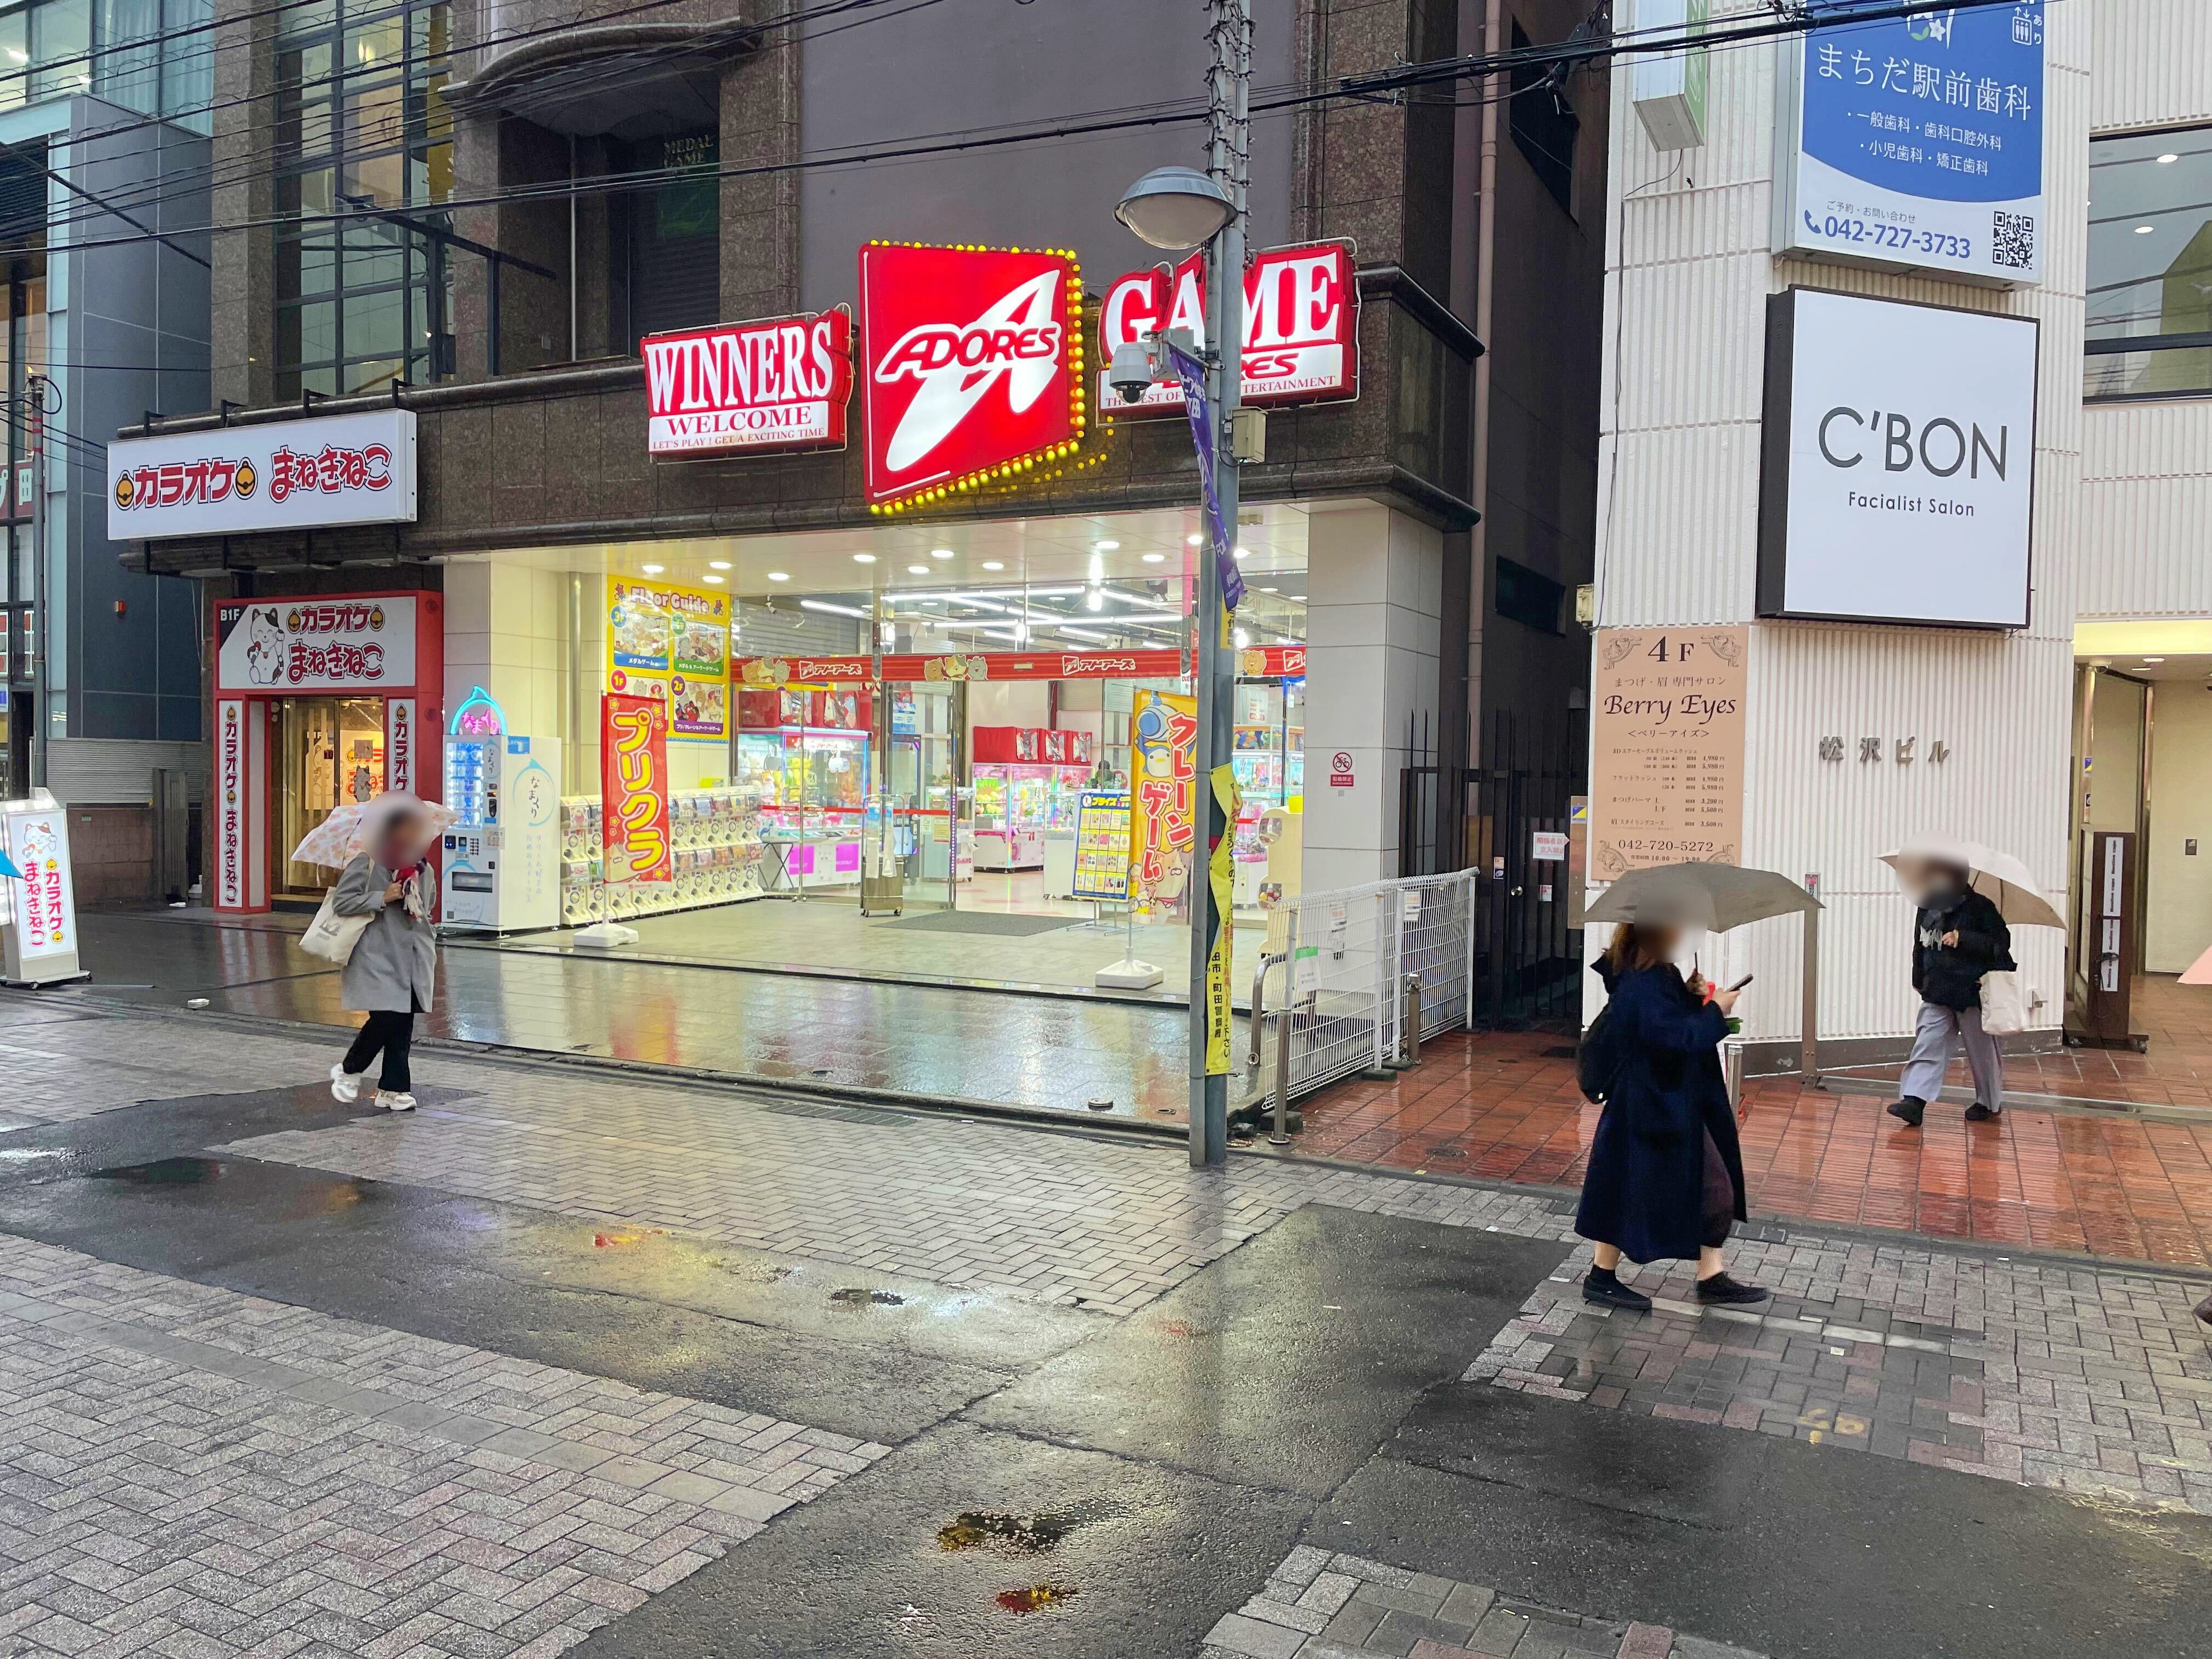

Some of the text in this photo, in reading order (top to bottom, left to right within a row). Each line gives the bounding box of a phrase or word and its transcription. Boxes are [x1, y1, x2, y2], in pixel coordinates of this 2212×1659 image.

[2033, 14, 2042, 44] あり
[1818, 43, 2031, 121] まちだ駅前歯科
[1827, 200, 1916, 224] ご予約・お問い合わせ
[1825, 216, 1971, 258] 042-727-3733
[1106, 252, 1340, 359] GAME
[645, 320, 832, 413] WINNERS
[881, 327, 1058, 375] ADORES
[1106, 375, 1335, 407] TH EST OF TERTAINMENT
[653, 441, 678, 449] LET'S
[682, 438, 705, 447] PLAY
[715, 436, 734, 444] GET
[748, 431, 794, 442] EXCITING
[798, 427, 825, 437] TIME
[667, 406, 812, 436] WELCOME
[1819, 407, 2007, 482] C'BON
[134, 444, 392, 507] カラオケ まねきねこ
[1849, 492, 1974, 516] Facialist Salon
[220, 610, 239, 622] B1F
[300, 605, 371, 633] カラオケ
[631, 586, 709, 614] Floor Guide
[287, 641, 385, 684] まねきねこ
[1604, 695, 1736, 725] Berry Eyes
[224, 721, 238, 790] カラオケ
[395, 721, 409, 791] カラオケ
[1819, 736, 1950, 763] 松沢ビル
[612, 708, 665, 871] プリクラ
[1167, 712, 1197, 847] クレーン
[1139, 780, 1173, 883] ゲーム
[1618, 839, 1713, 852] 042-720-5272
[224, 808, 239, 905] まねきねこ
[23, 860, 47, 947] まねきねこ
[45, 871, 63, 931] カラオケ
